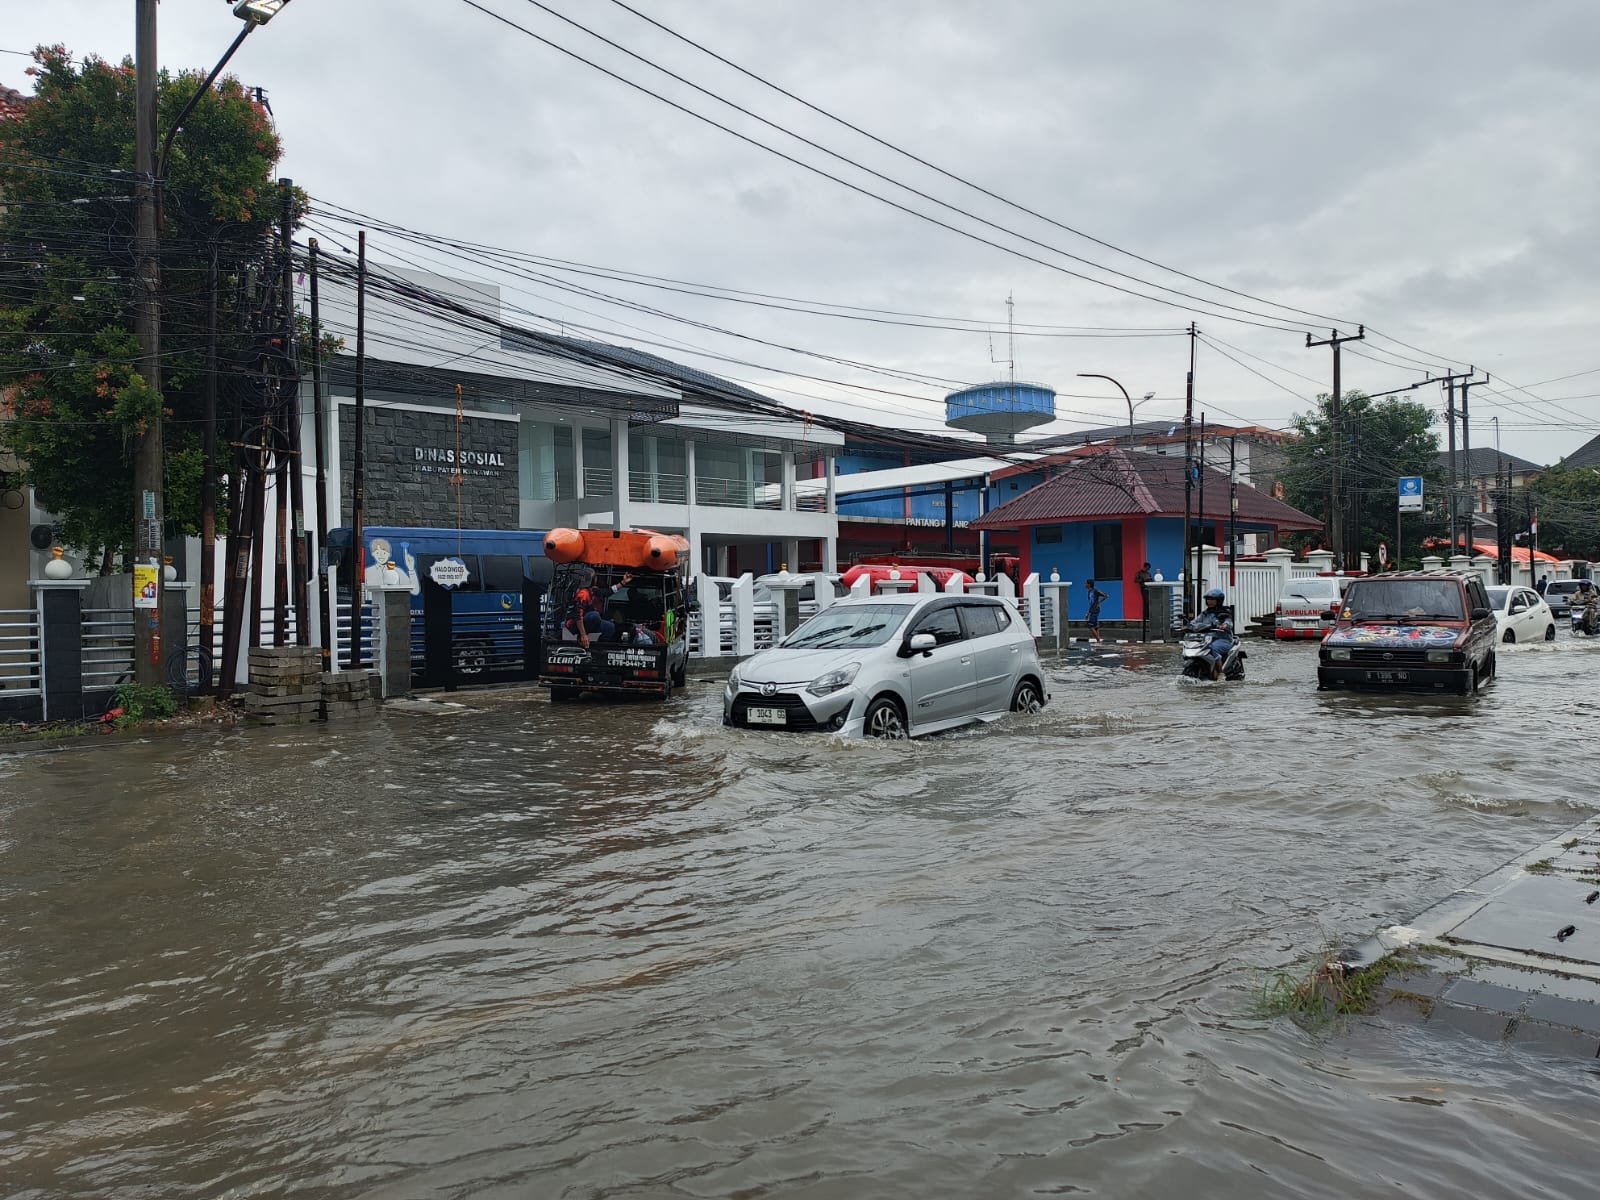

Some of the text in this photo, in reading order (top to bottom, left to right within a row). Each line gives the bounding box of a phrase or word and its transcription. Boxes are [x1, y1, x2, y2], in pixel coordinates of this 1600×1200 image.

[415, 447, 505, 466] DINAS SOSIAL
[905, 517, 940, 529] PANTANG
